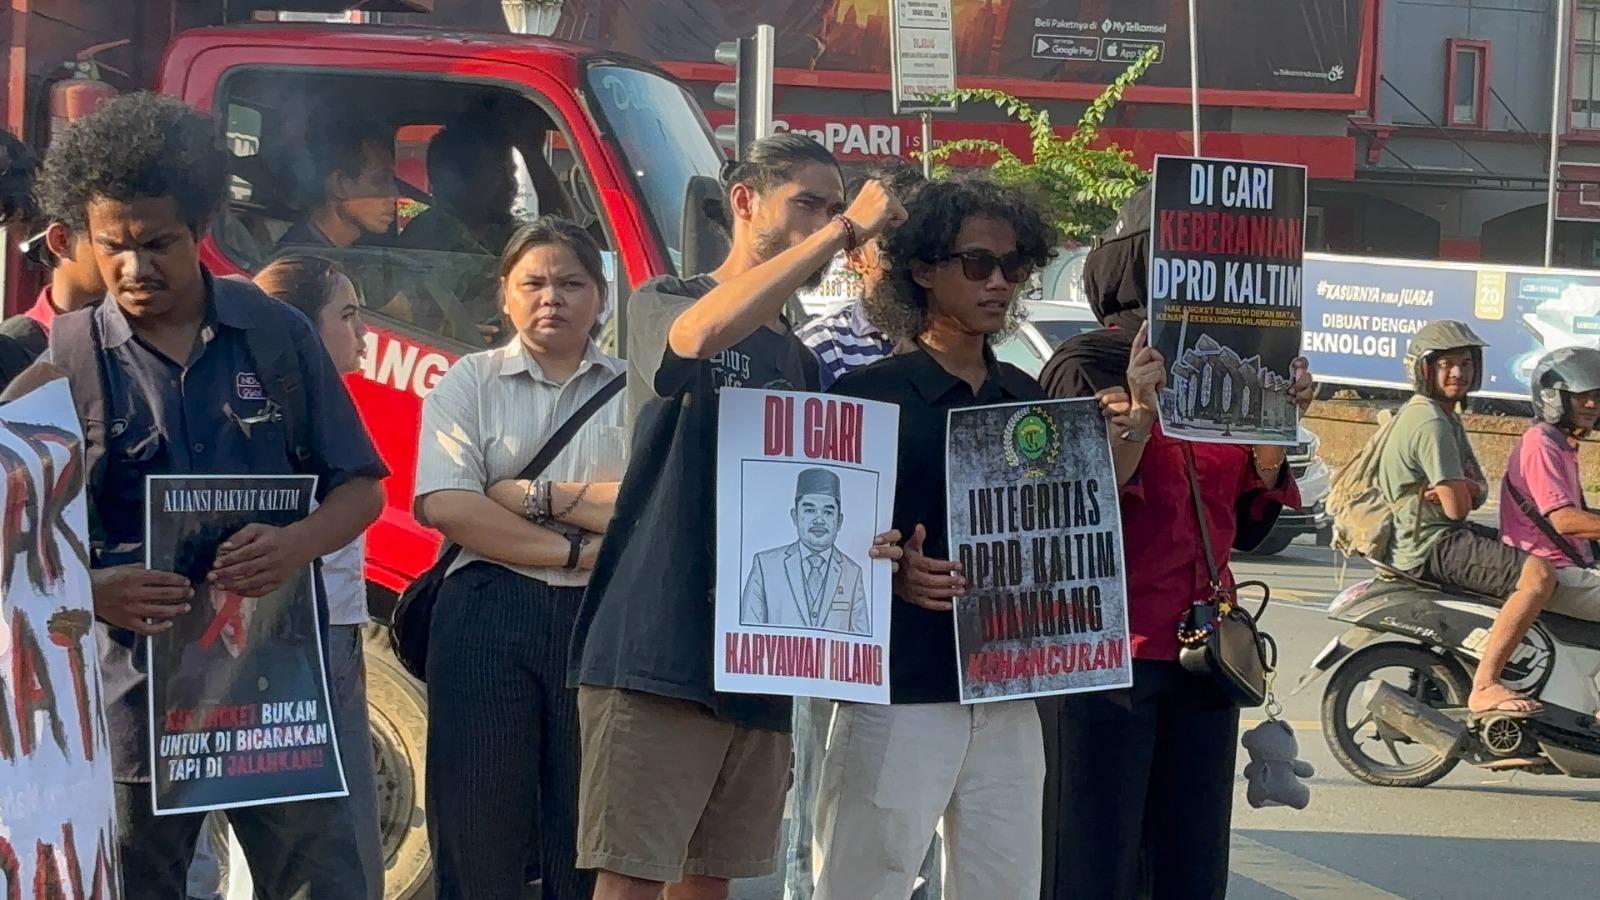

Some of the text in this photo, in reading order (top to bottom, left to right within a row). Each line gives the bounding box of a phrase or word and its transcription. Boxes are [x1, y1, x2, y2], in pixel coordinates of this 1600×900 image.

[1035, 18, 1097, 31] Beli Paketnya di
[1052, 45, 1094, 57] Google Play
[1120, 49, 1136, 59] App
[1190, 163, 1274, 210] DI CARI
[1159, 209, 1301, 259] KEBERANIAN
[1153, 257, 1301, 307] DPRD KALTIM
[1397, 288, 1434, 307] JUARA
[1322, 313, 1370, 330] DIBUAT
[1302, 331, 1396, 358] EKNOLOGI
[764, 394, 864, 464] DI CARI
[163, 488, 300, 512] ALIANSI RAKYAT KALTIM
[968, 478, 1101, 536] INTEGRITAS
[959, 531, 1116, 590] DPRD KALTIM
[978, 585, 1103, 643] DIAMBANG
[725, 632, 883, 687] KARYAWAN HILANG
[966, 638, 1124, 684] KEHANCURAN
[261, 700, 317, 725] BUKAN
[159, 723, 328, 757] UNTUK DI BICARAKAN
[168, 758, 200, 782] TAPI
[206, 757, 222, 778] DI
